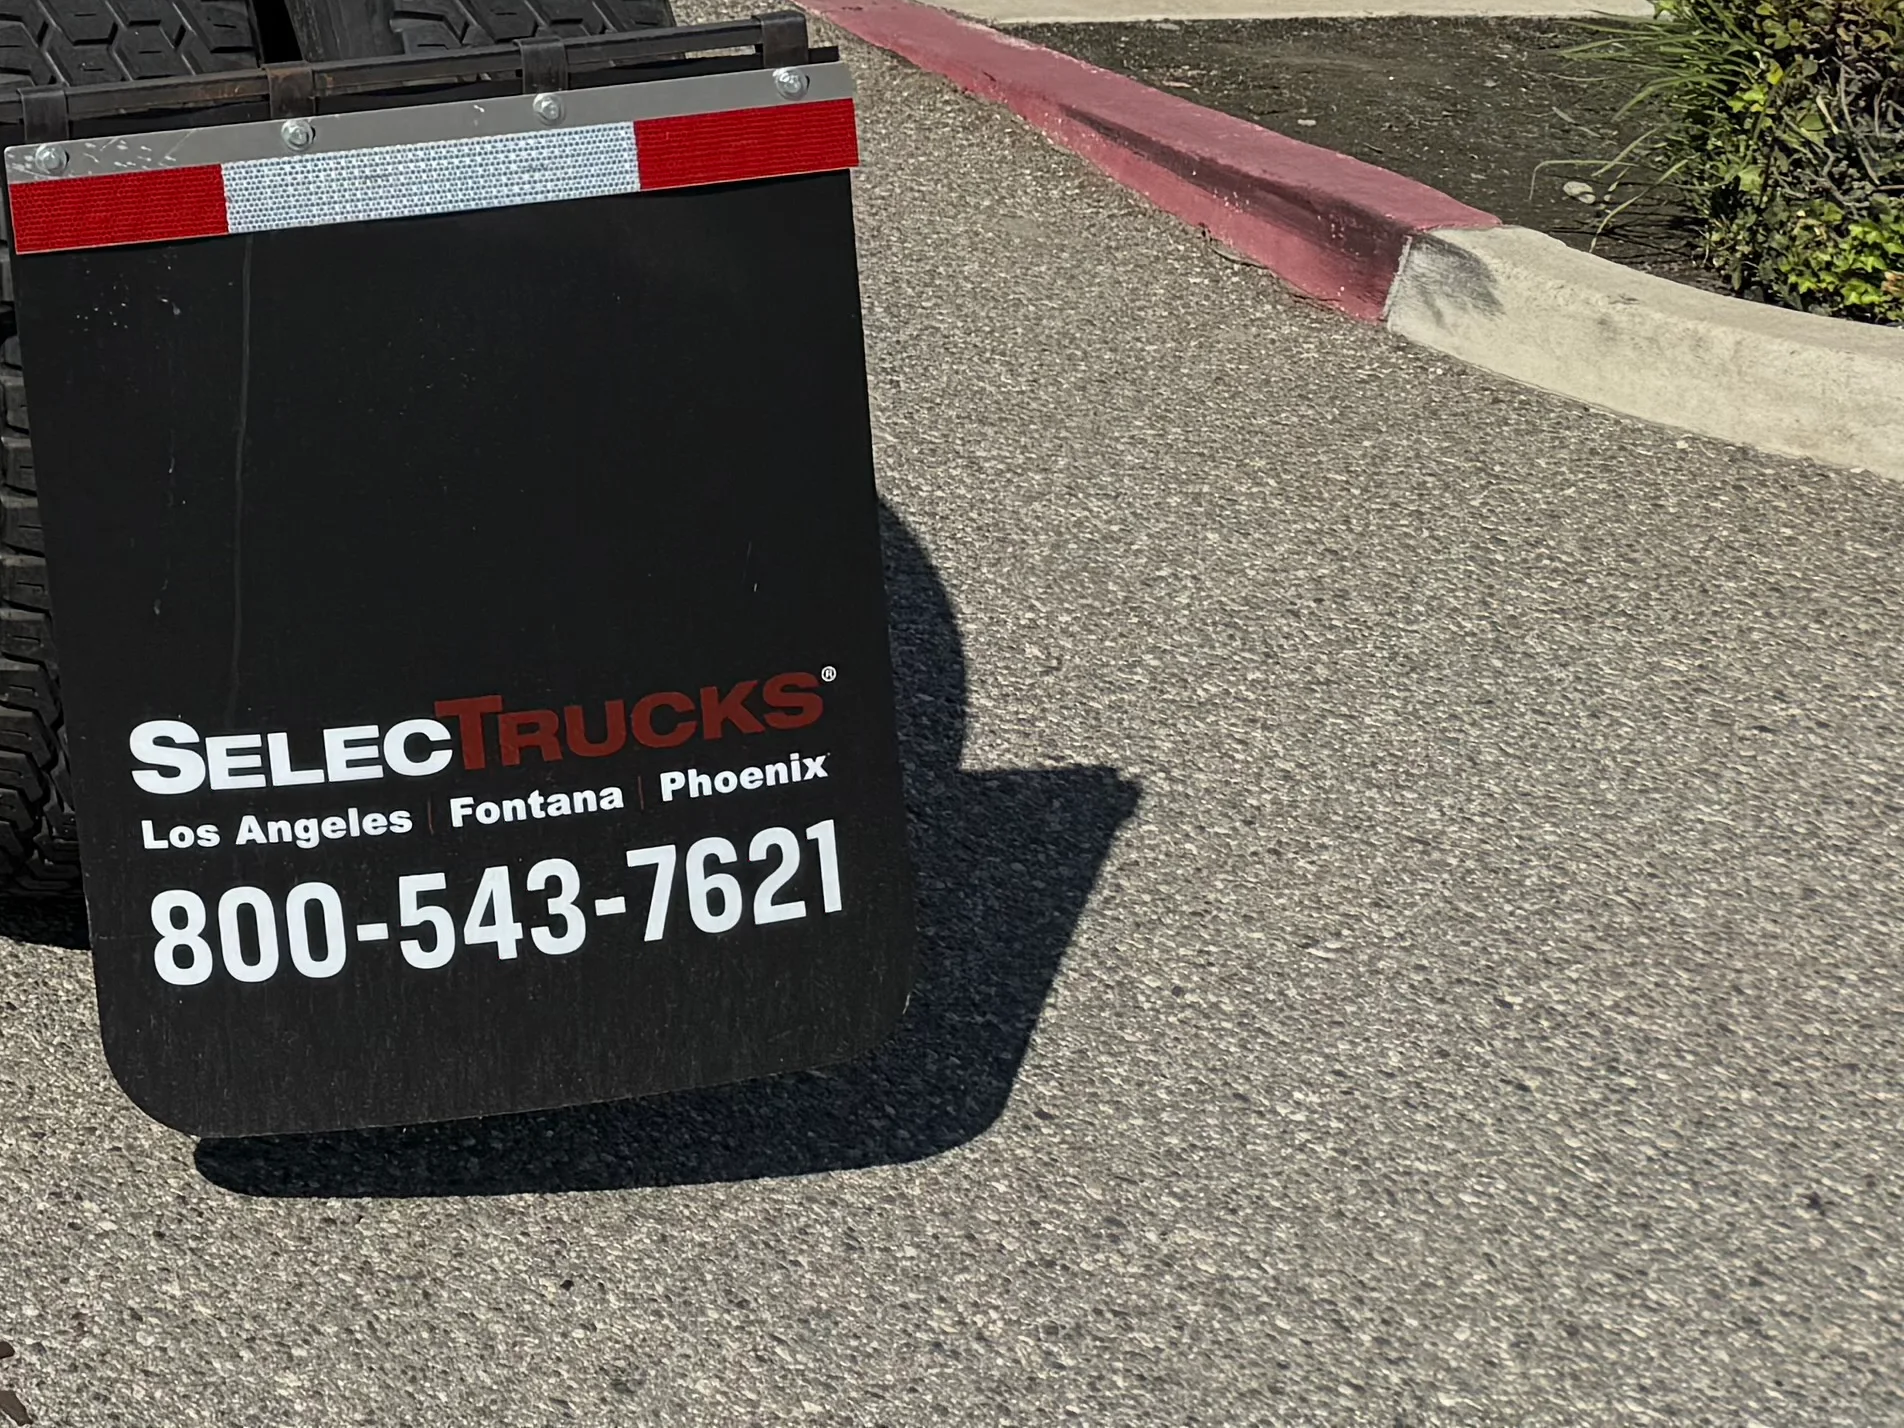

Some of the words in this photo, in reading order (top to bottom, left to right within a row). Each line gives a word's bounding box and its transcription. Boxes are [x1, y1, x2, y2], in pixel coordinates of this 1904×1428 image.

[140, 819, 221, 850] Los
[235, 806, 413, 849] Angeles
[449, 784, 625, 829] Fontana
[659, 753, 829, 803] Phoenix
[150, 819, 843, 986] 800-543-7621
